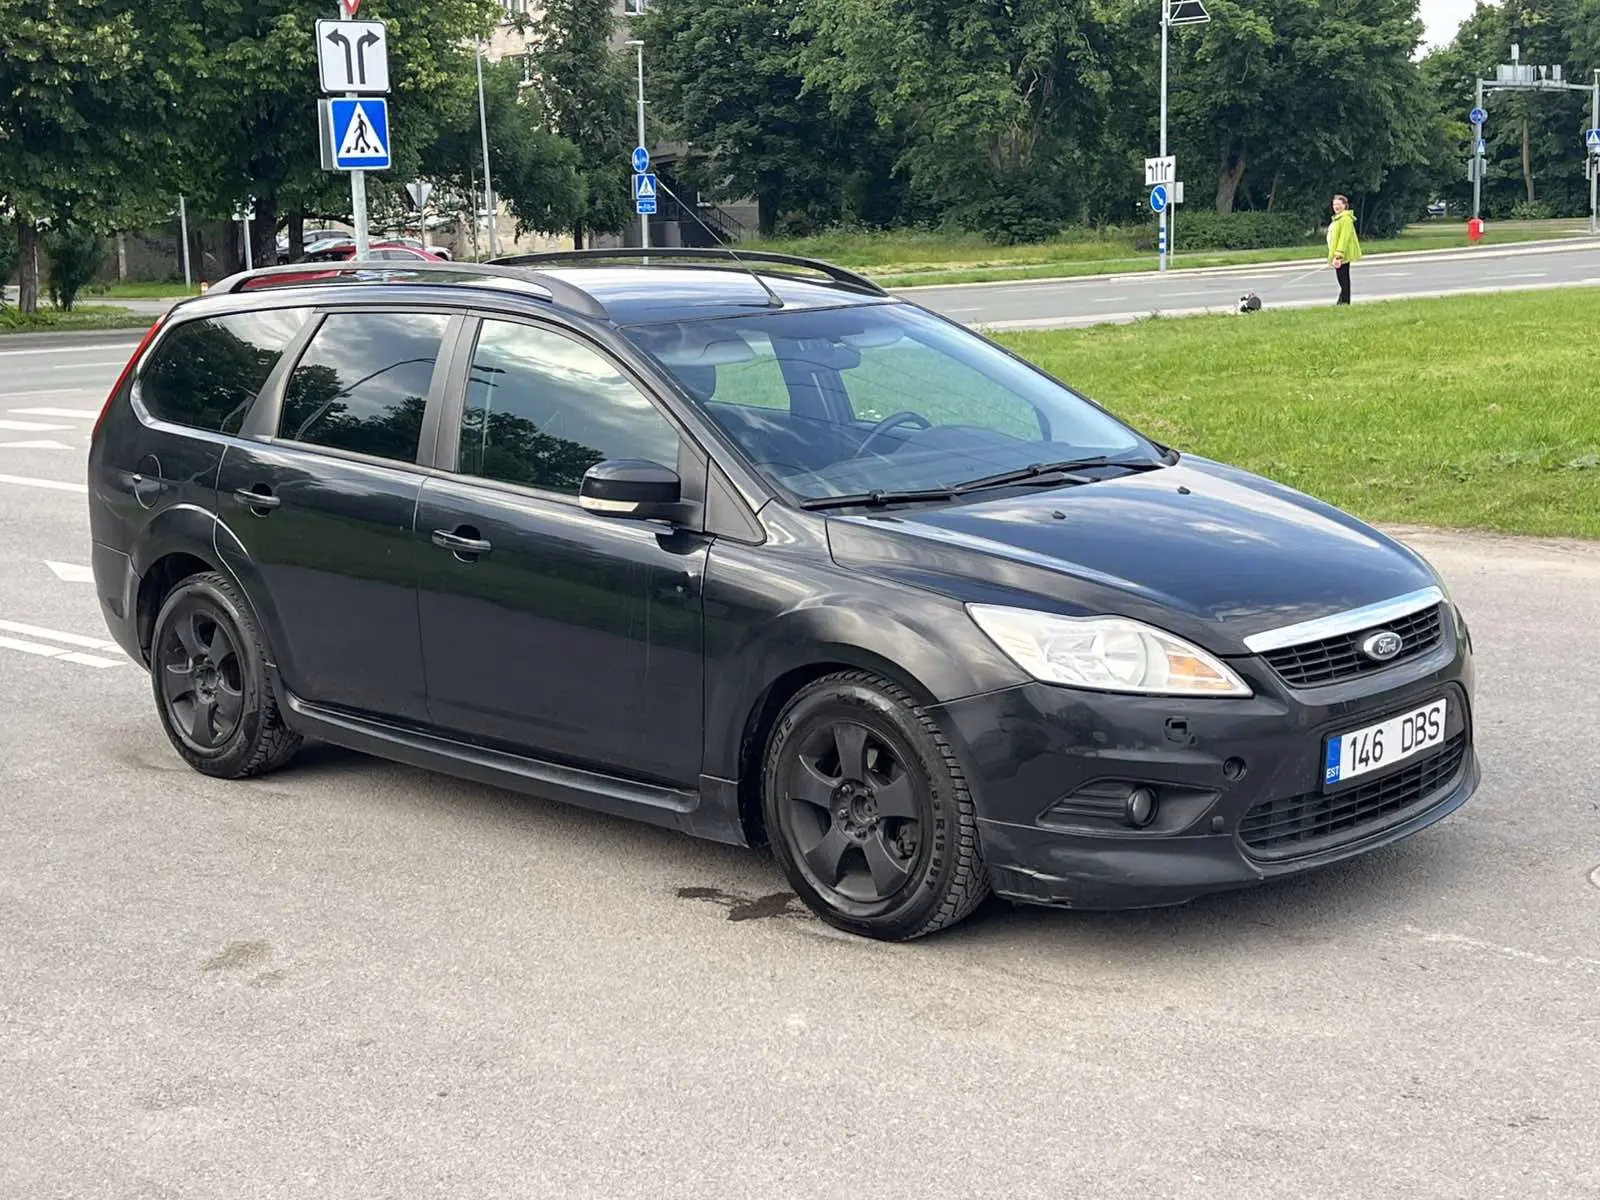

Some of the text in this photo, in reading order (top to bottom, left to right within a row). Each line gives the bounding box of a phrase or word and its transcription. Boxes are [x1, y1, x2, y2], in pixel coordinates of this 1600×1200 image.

[1378, 637, 1397, 654] Ford
[1349, 707, 1440, 771] 146 DBS
[1326, 766, 1340, 778] EST
